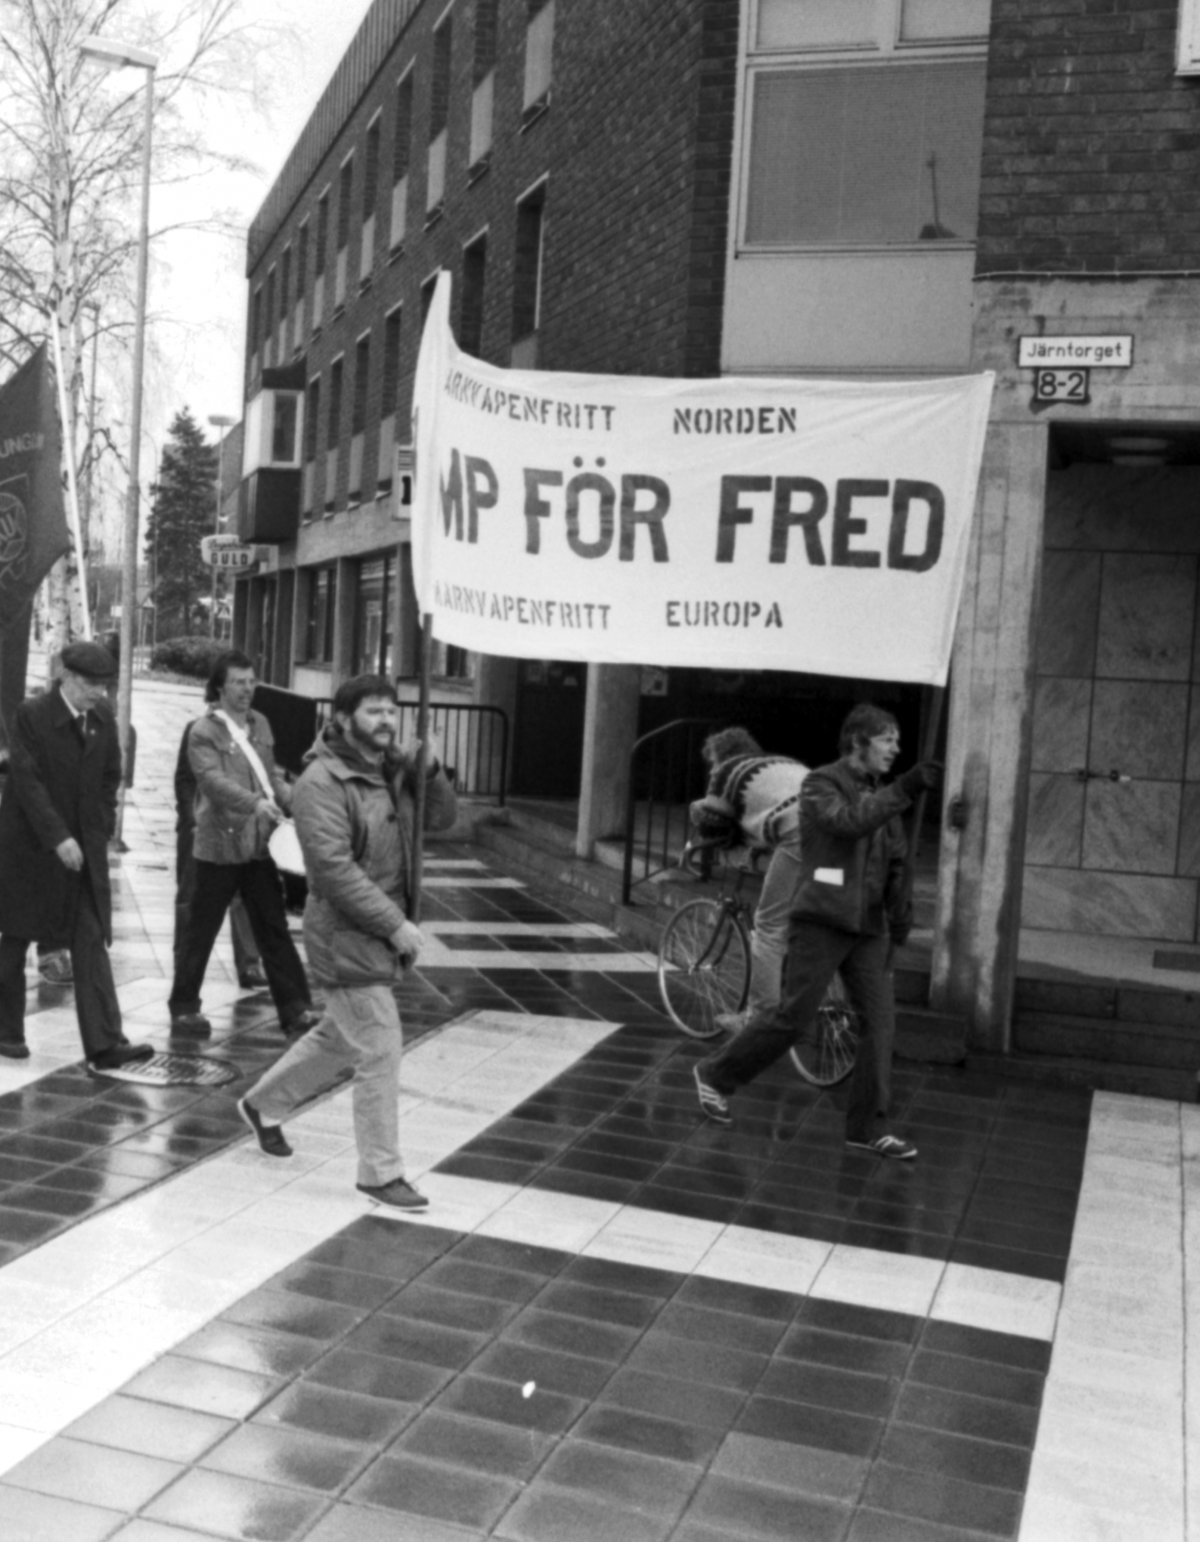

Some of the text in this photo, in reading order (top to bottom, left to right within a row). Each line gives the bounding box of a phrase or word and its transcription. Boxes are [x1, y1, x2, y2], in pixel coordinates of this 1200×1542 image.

[1027, 342, 1122, 362] Järntorget
[1039, 372, 1085, 397] 8-2
[674, 407, 796, 434] NORDEN
[439, 447, 946, 574] MP FÖR FRED
[666, 601, 783, 628] EUROPA
